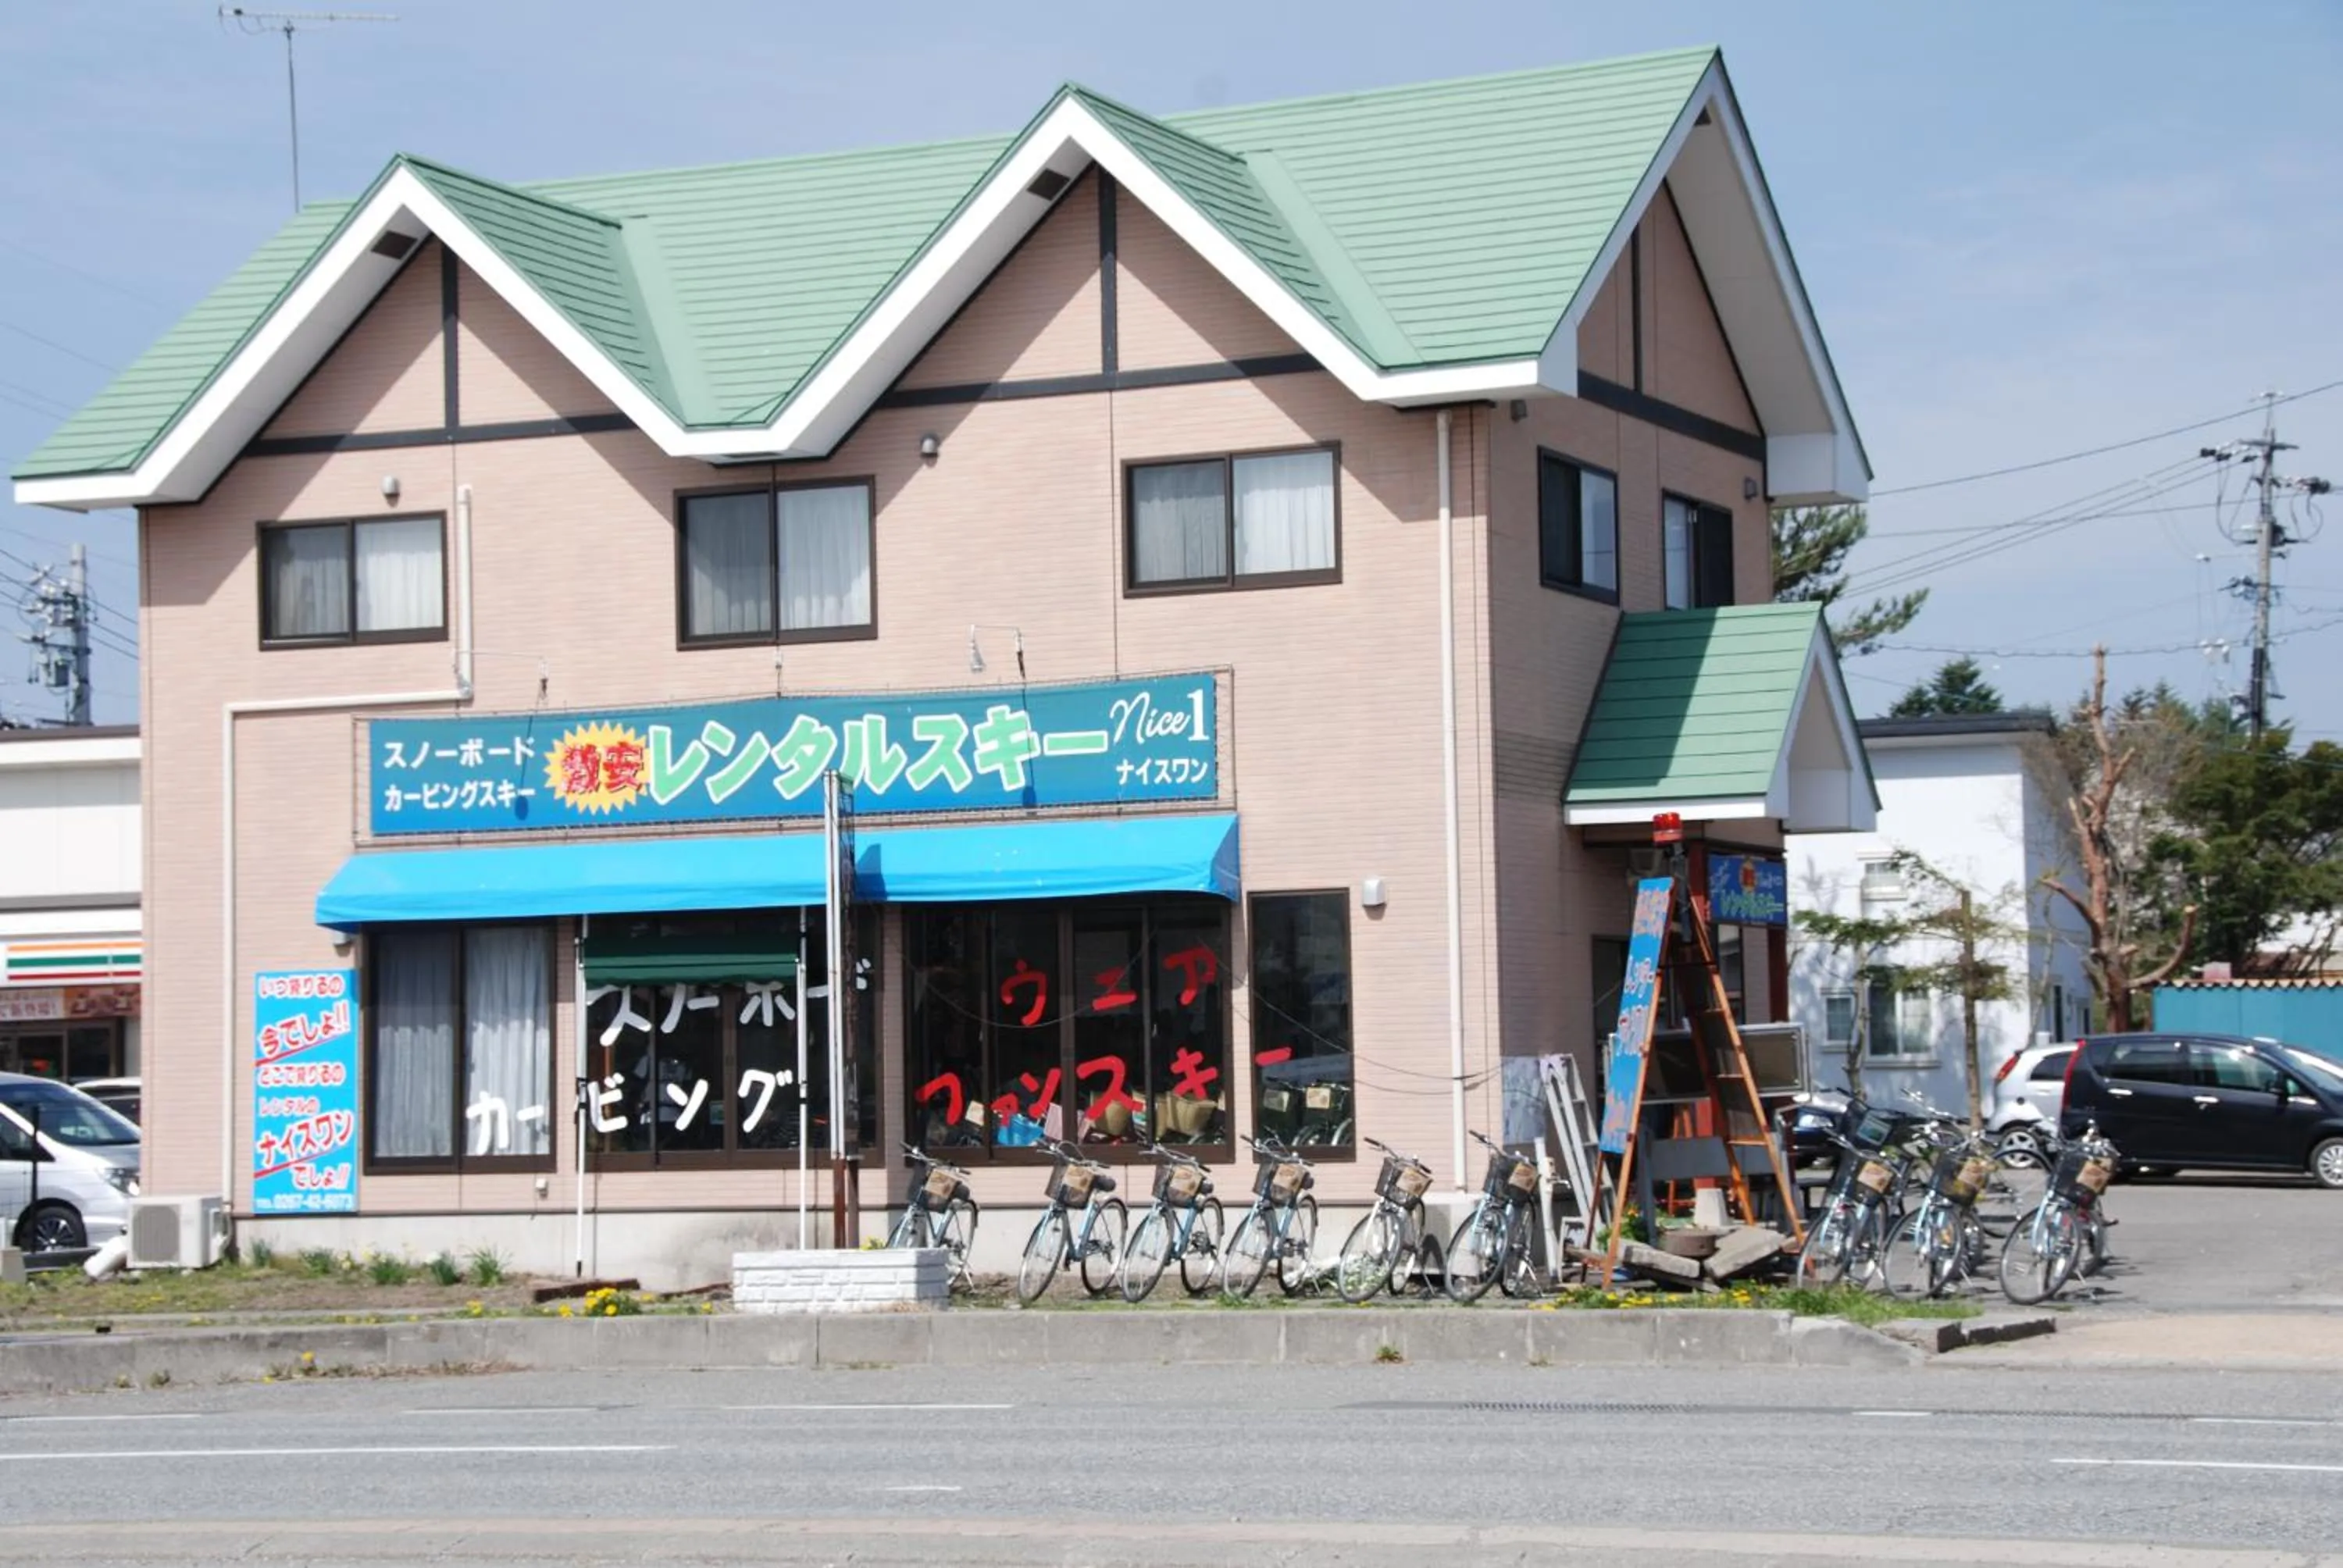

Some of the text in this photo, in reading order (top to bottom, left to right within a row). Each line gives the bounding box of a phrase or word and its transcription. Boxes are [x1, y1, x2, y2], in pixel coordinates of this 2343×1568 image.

[383, 736, 536, 768] スノーボード
[560, 741, 645, 795] 激安
[648, 704, 1108, 804] レンタルスキー
[1115, 757, 1209, 786] ナイスワン
[383, 779, 536, 812] カービングスキー
[258, 1110, 354, 1167] ナイスワン
